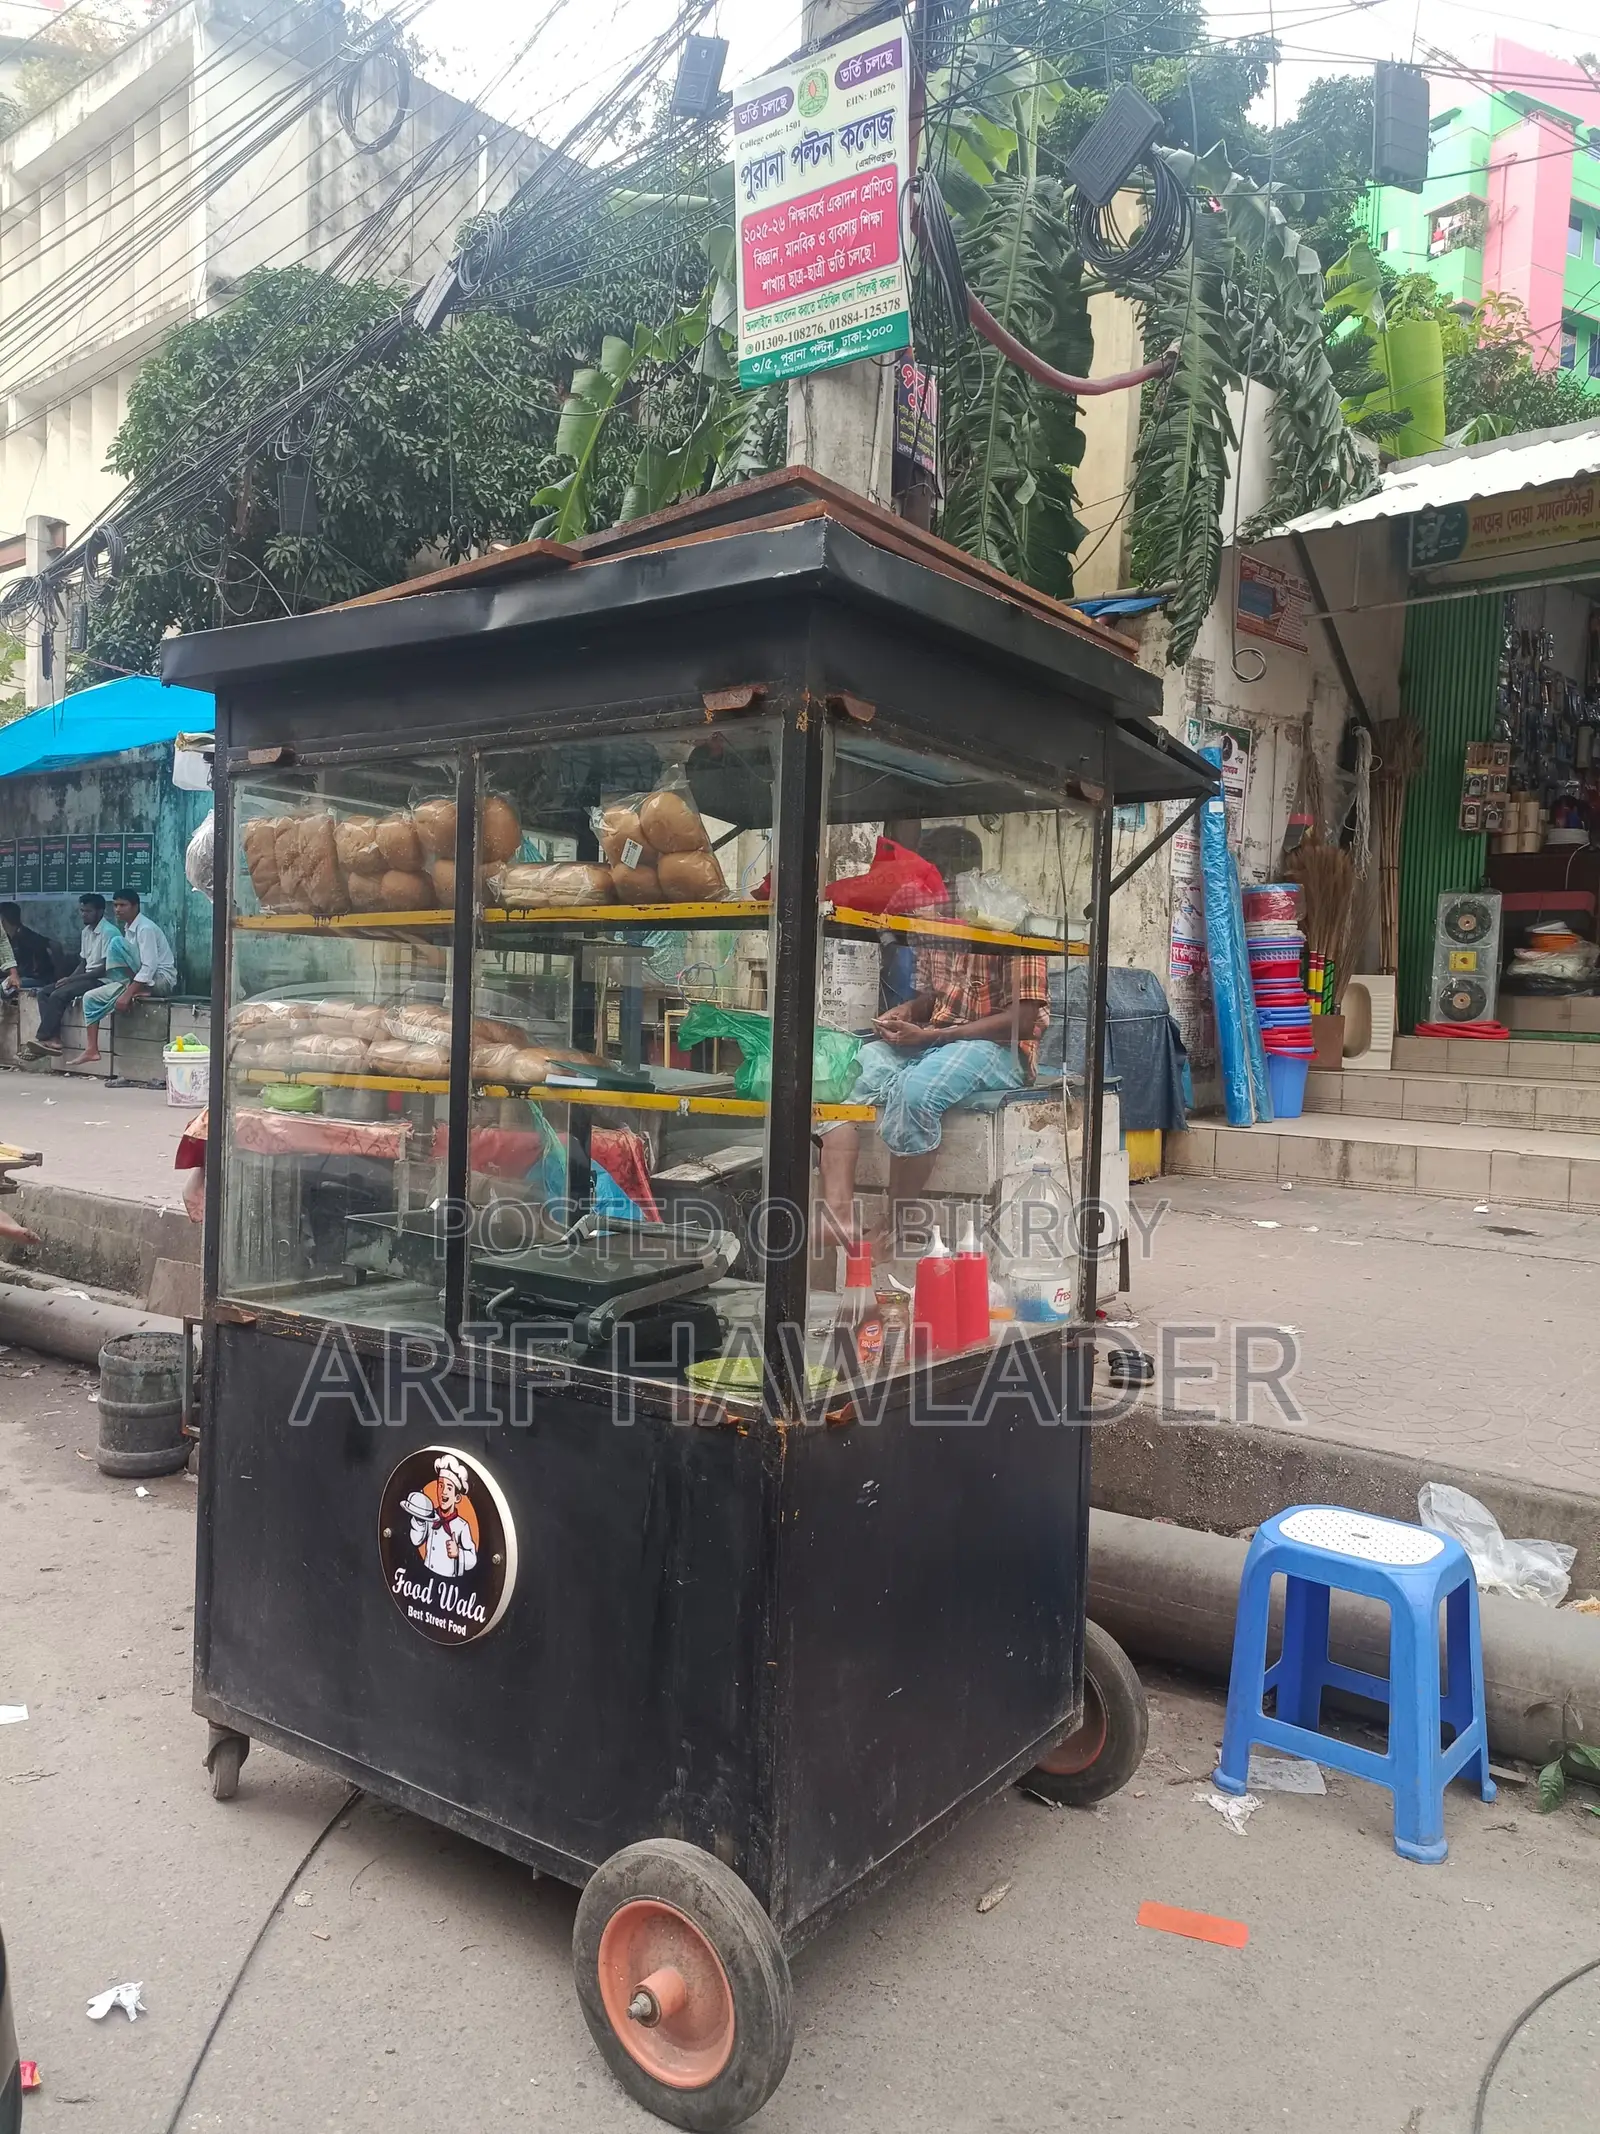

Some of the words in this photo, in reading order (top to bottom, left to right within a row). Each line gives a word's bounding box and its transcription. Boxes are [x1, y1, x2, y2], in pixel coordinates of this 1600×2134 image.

[840, 54, 862, 83] ভর্তি
[864, 48, 894, 75] চলছে
[738, 101, 759, 125] ভর্তি
[761, 93, 788, 117] চলছে
[846, 93, 867, 108] EIIN:
[869, 83, 896, 99] 108276
[739, 135, 764, 151] College
[765, 128, 784, 141] code:
[785, 120, 801, 133] 1501
[741, 151, 786, 202] পুরানা
[790, 130, 835, 174] পল্টন
[838, 108, 896, 156] কলেজ
[744, 217, 786, 245] ২০২৫-২৬
[788, 194, 825, 228] শিক্ষাবর্ষে
[827, 186, 858, 212] একাদশ
[860, 176, 894, 202] শ্রেণিতে
[784, 230, 816, 259] মানবিক
[818, 232, 826, 247] ও
[827, 217, 858, 244] ব্যবসায়
[859, 209, 884, 232] শিক্ষা
[761, 272, 786, 297] শাখায়
[788, 254, 825, 289] ছাত্র-ছাত্রী
[827, 246, 847, 273] ভর্তি
[848, 242, 877, 266] চলছে!
[755, 322, 827, 353] 01309-108276,
[829, 297, 901, 331] 01884-125378
[780, 345, 807, 367] পুরানা
[841, 323, 894, 348] ঢাকা-১০০০
[1472, 511, 1503, 535] মায়ের
[1507, 505, 1533, 531] দোয়া
[392, 1567, 433, 1605] Food
[437, 1581, 486, 1624] Wala
[407, 1605, 424, 1621] Best
[425, 1611, 447, 1630] Street
[448, 1619, 467, 1637] Food
